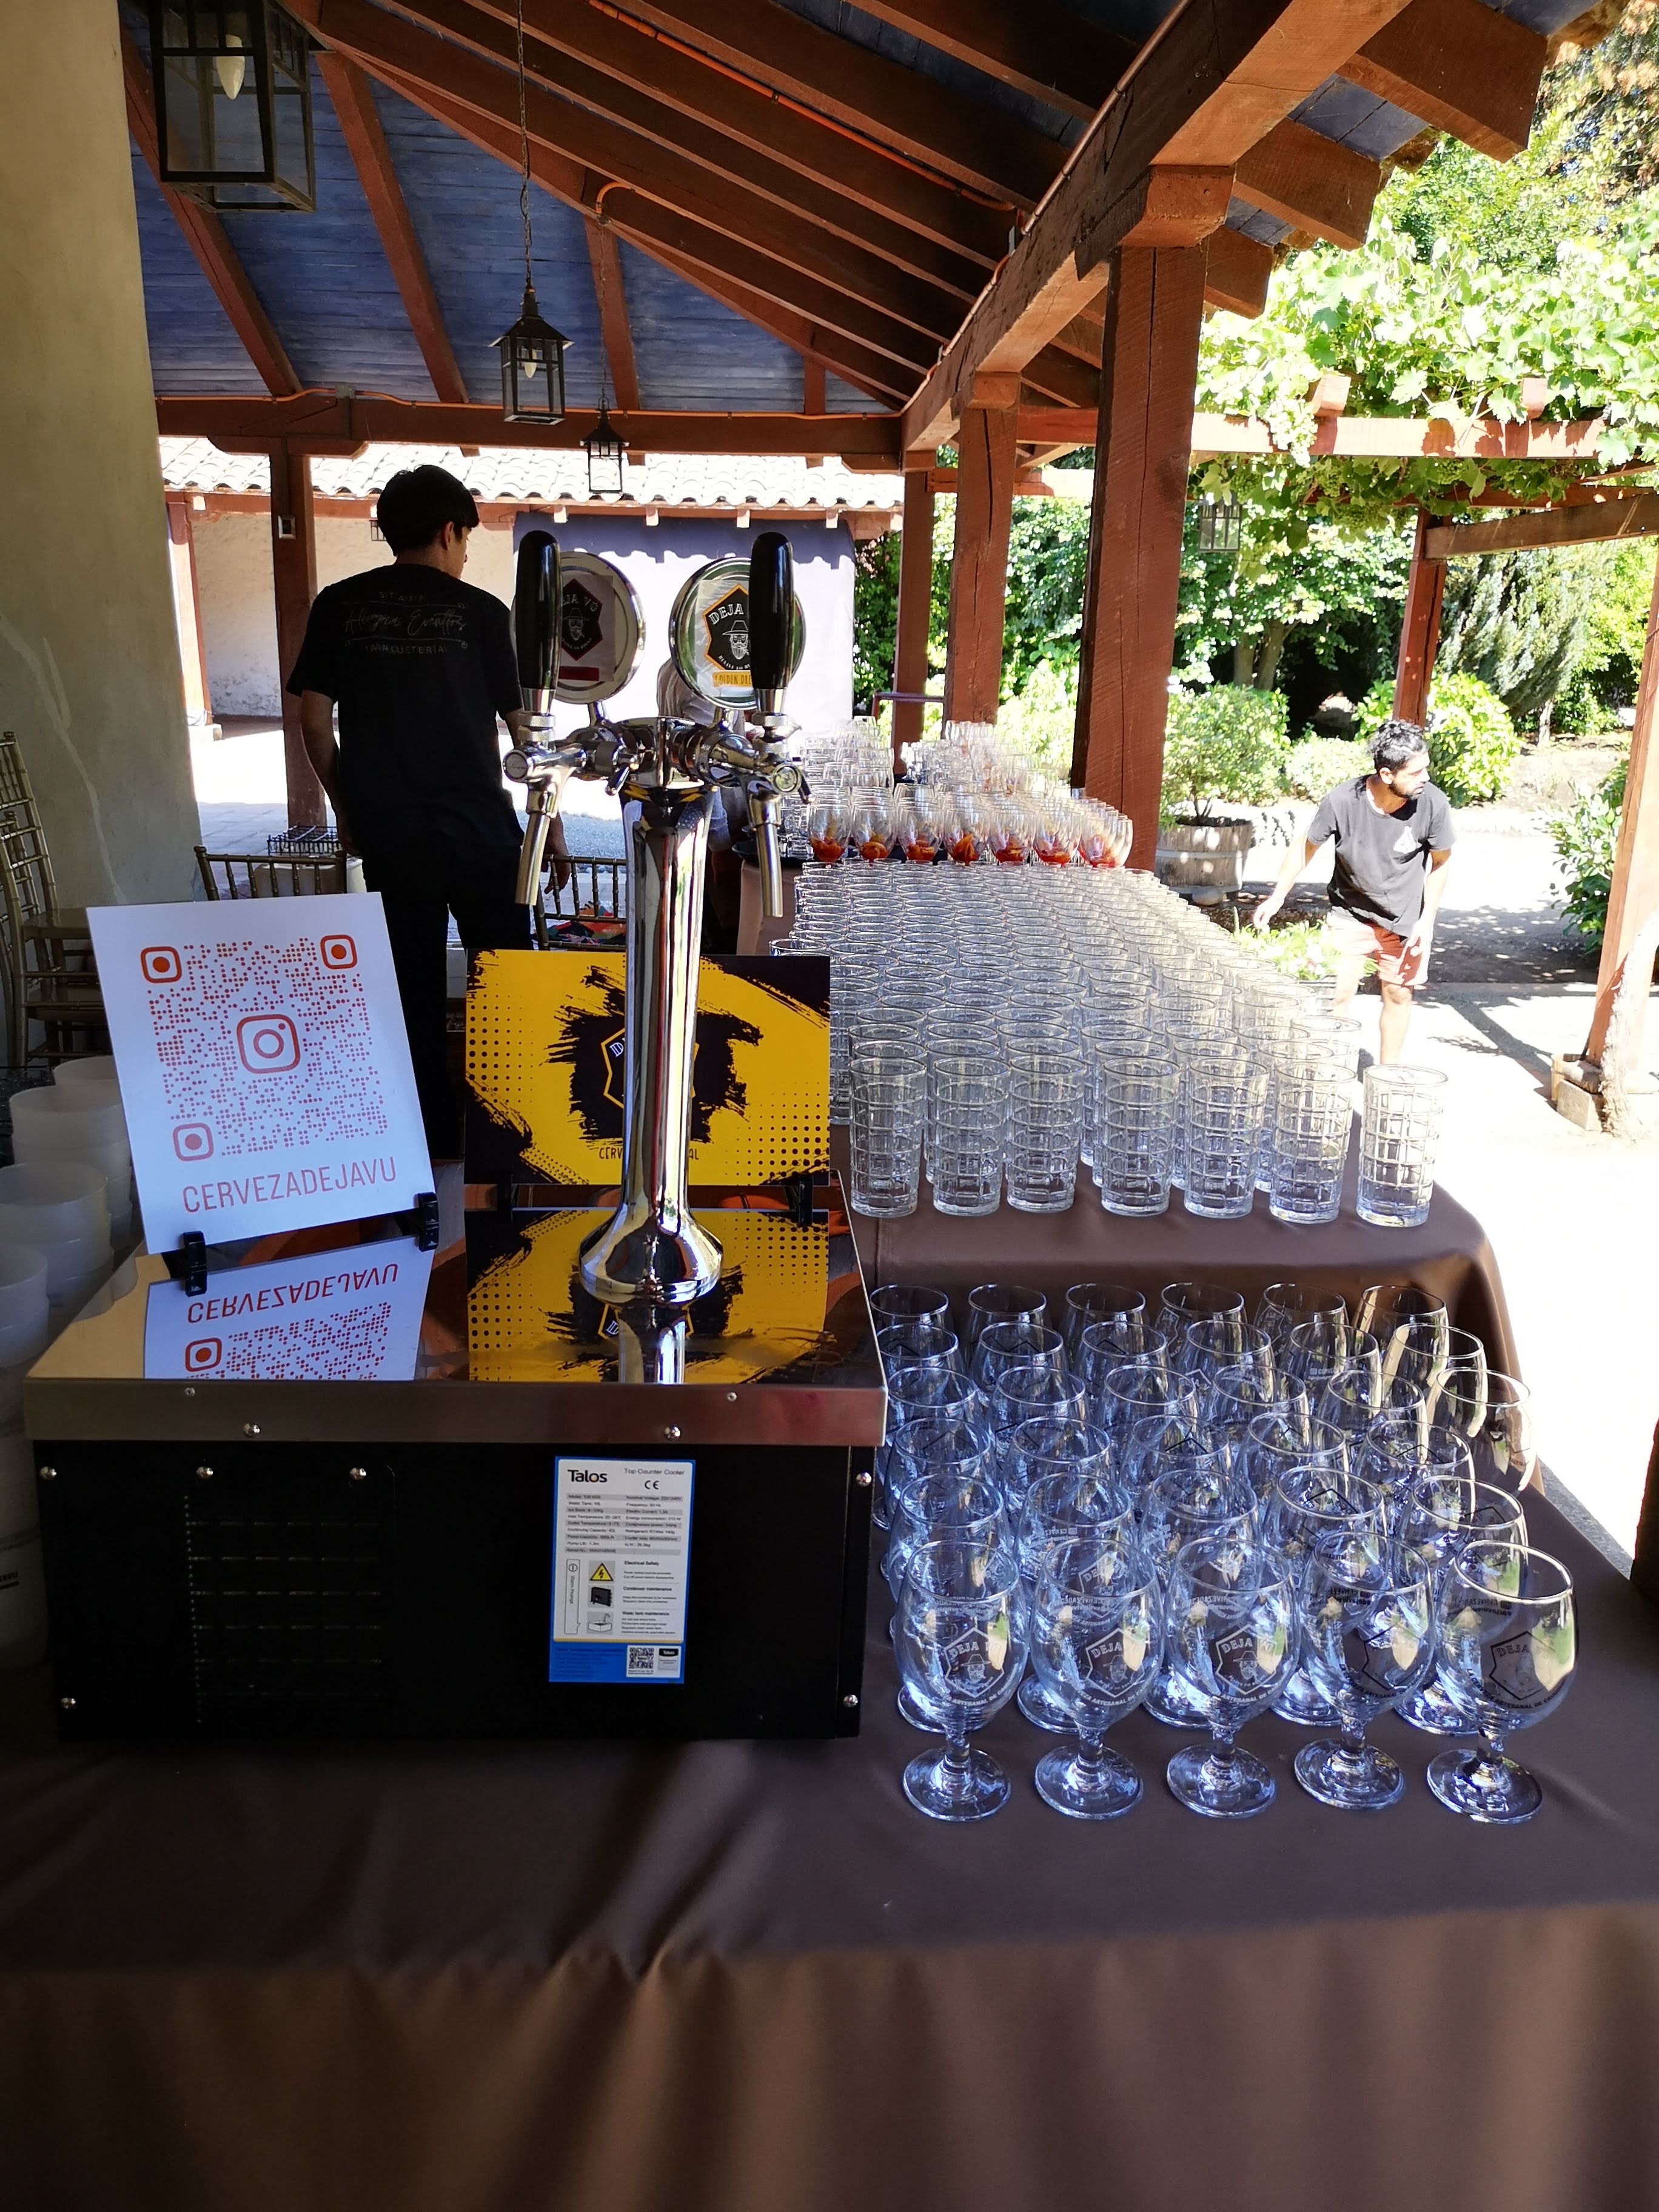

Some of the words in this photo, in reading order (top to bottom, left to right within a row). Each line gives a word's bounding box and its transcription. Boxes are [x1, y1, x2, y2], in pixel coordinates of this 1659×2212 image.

[708, 603, 744, 625] DEJA
[599, 1147, 623, 1159] CERV
[183, 1156, 398, 1213] CERVEZADEJAVU
[567, 1469, 608, 1483] Talos
[645, 1480, 659, 1490] CE
[948, 1641, 980, 1660] DEJA
[1091, 1641, 1122, 1658] DEJA
[1221, 1637, 1253, 1654] DEJA
[1495, 1644, 1530, 1657] DEJA
[1091, 1697, 1127, 1706] ARTESANAL
